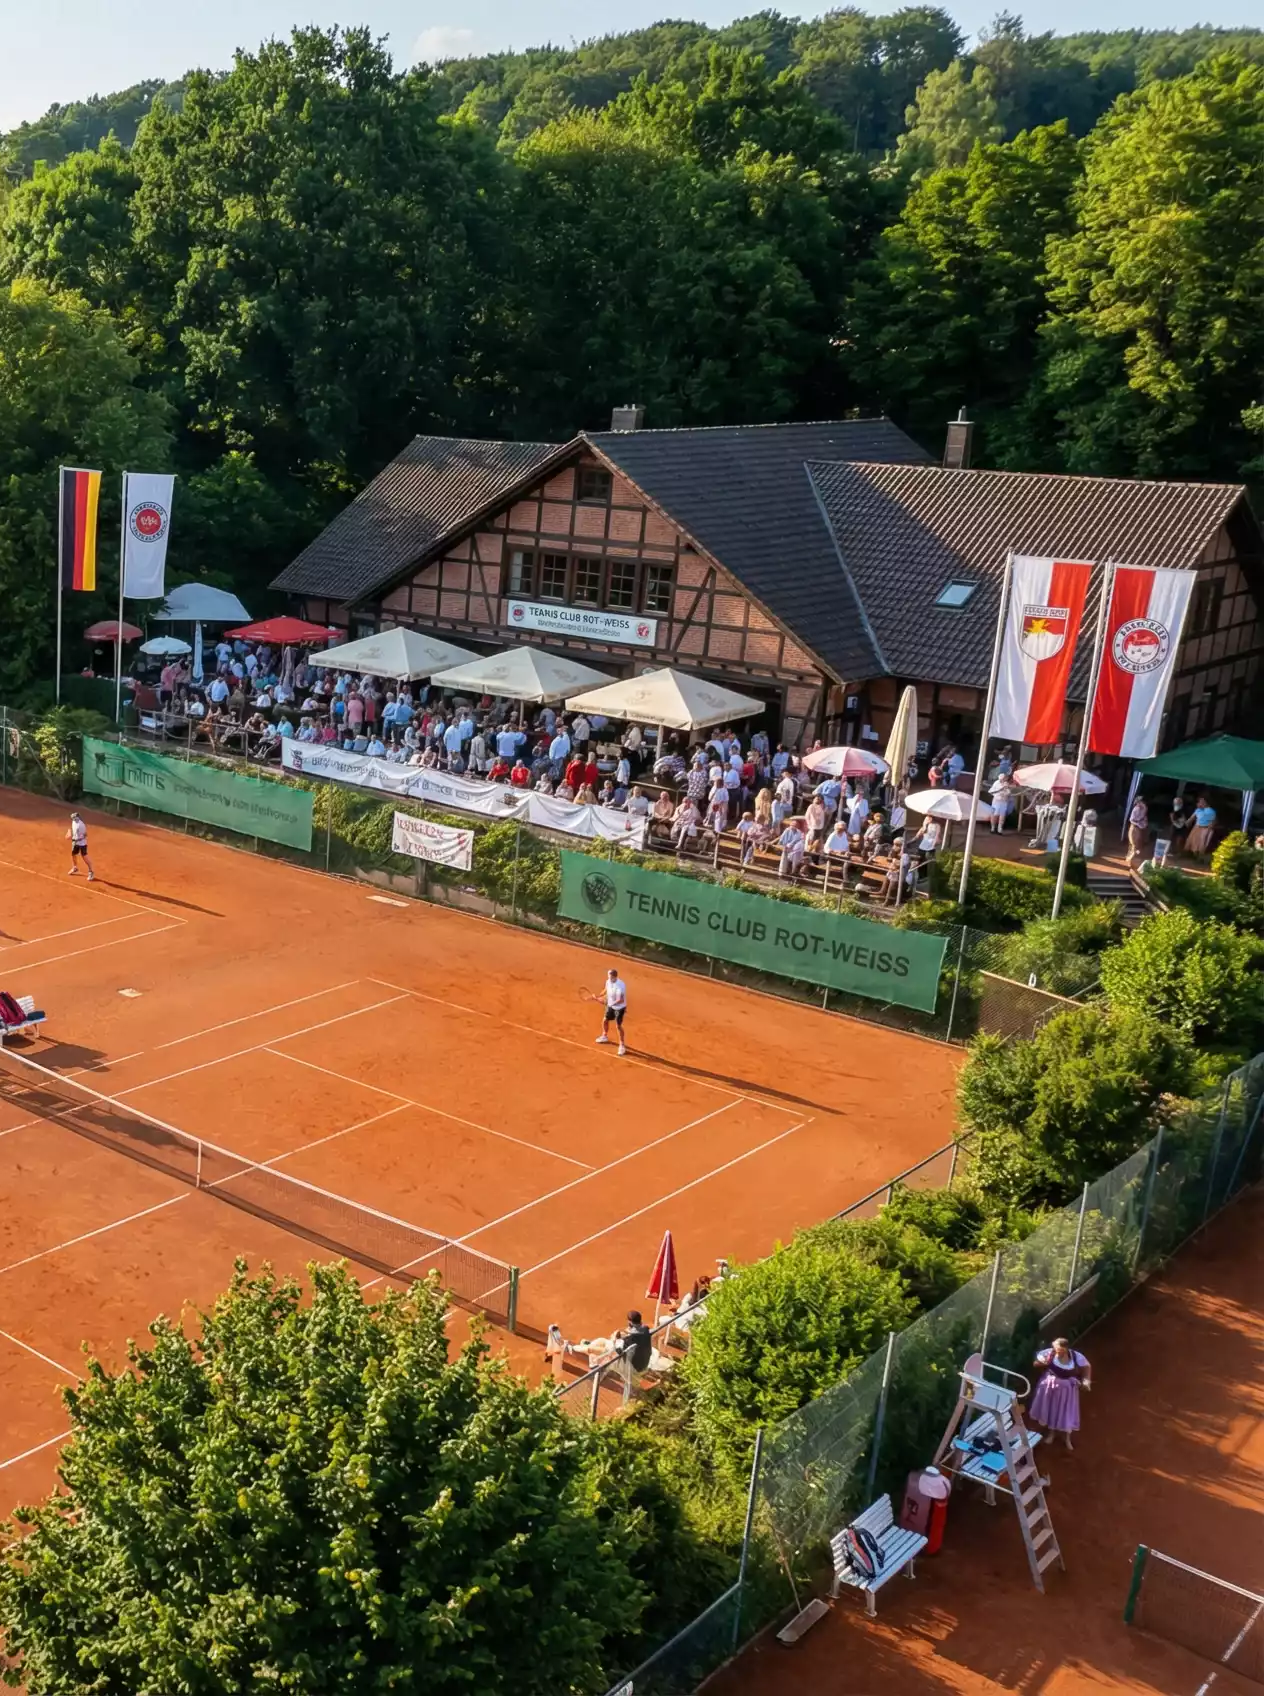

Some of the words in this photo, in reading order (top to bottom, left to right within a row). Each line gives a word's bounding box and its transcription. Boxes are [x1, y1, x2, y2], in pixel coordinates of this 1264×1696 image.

[626, 889, 701, 926] TENNIS
[707, 911, 766, 942] CLUB
[774, 927, 910, 977] ROT-WEISS
